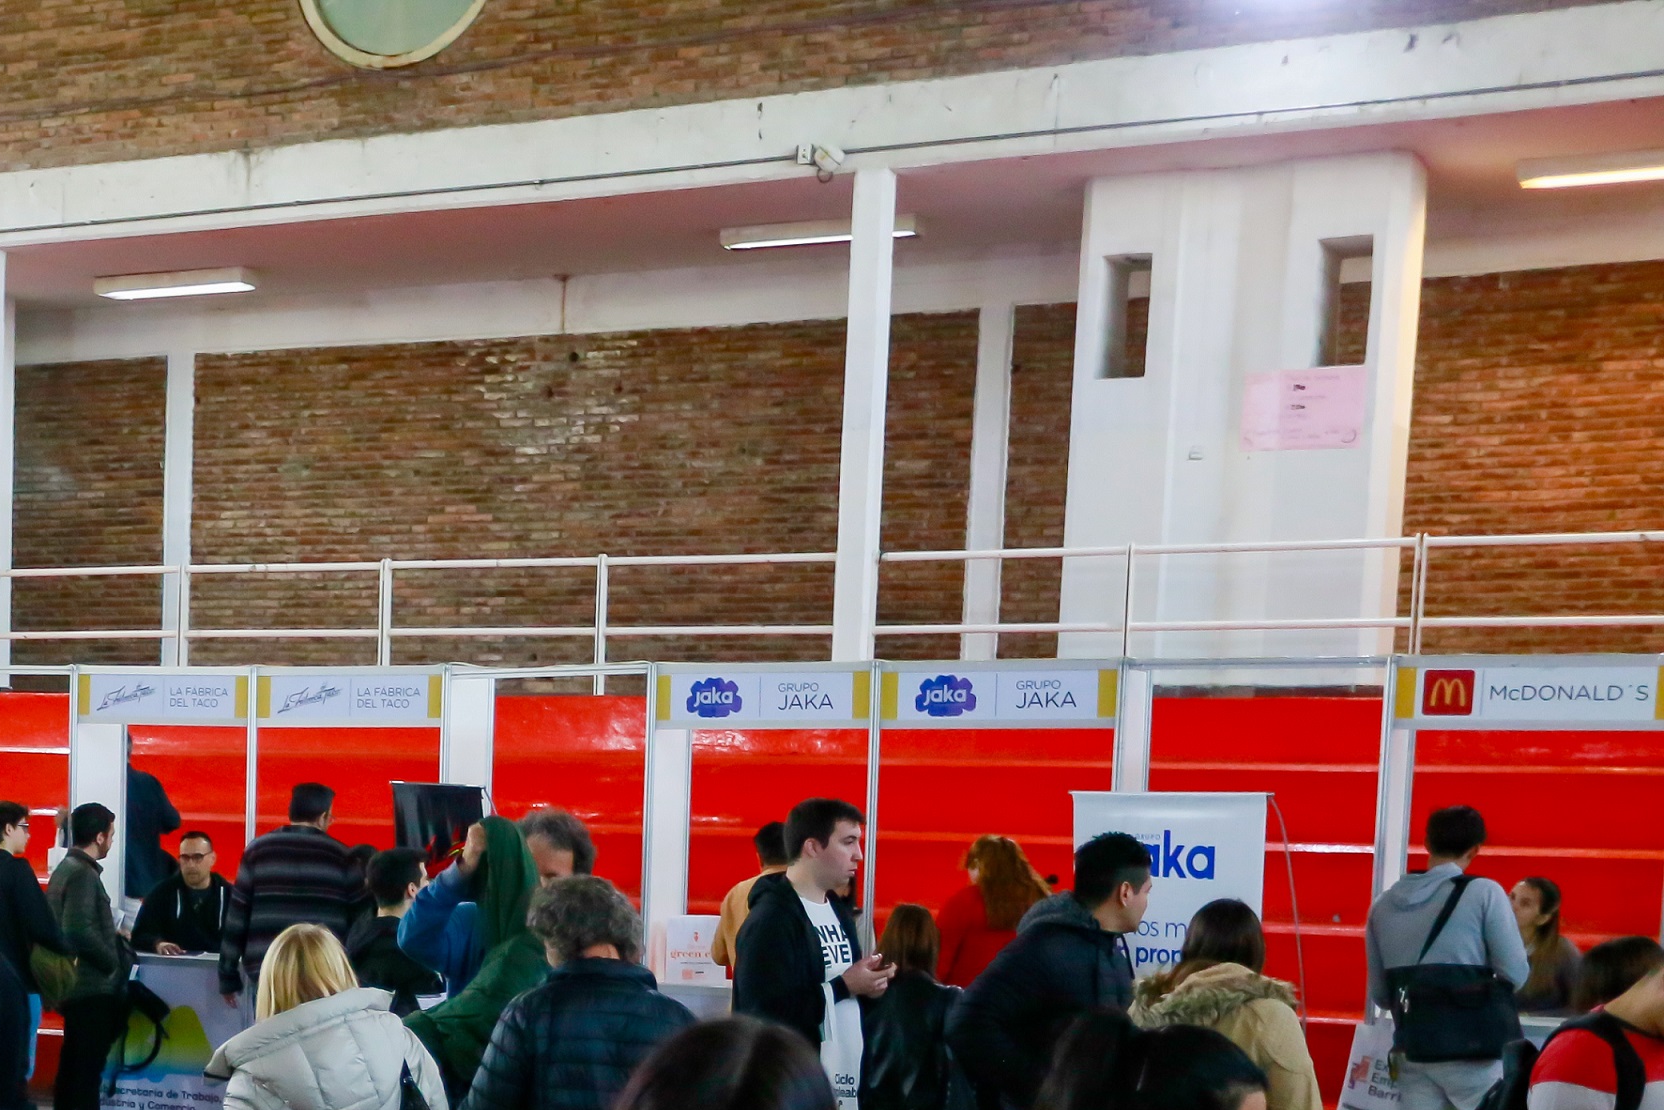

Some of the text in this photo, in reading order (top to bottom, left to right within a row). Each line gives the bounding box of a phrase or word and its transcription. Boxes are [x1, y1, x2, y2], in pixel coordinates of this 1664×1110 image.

[777, 682, 819, 693] GRUPO
[1015, 679, 1062, 690] GRUPO
[169, 687, 182, 697] LA
[357, 687, 370, 697] LA
[693, 686, 734, 708] jaka
[923, 684, 967, 706] jaka
[169, 698, 219, 709] DEL TACO
[357, 698, 410, 710] DEL TACO
[777, 693, 834, 711] JAKA
[1015, 691, 1077, 709] JAKA
[1371, 1072, 1398, 1089] Emp
[165, 1087, 179, 1099] de
[1368, 1084, 1402, 1103] Barri
